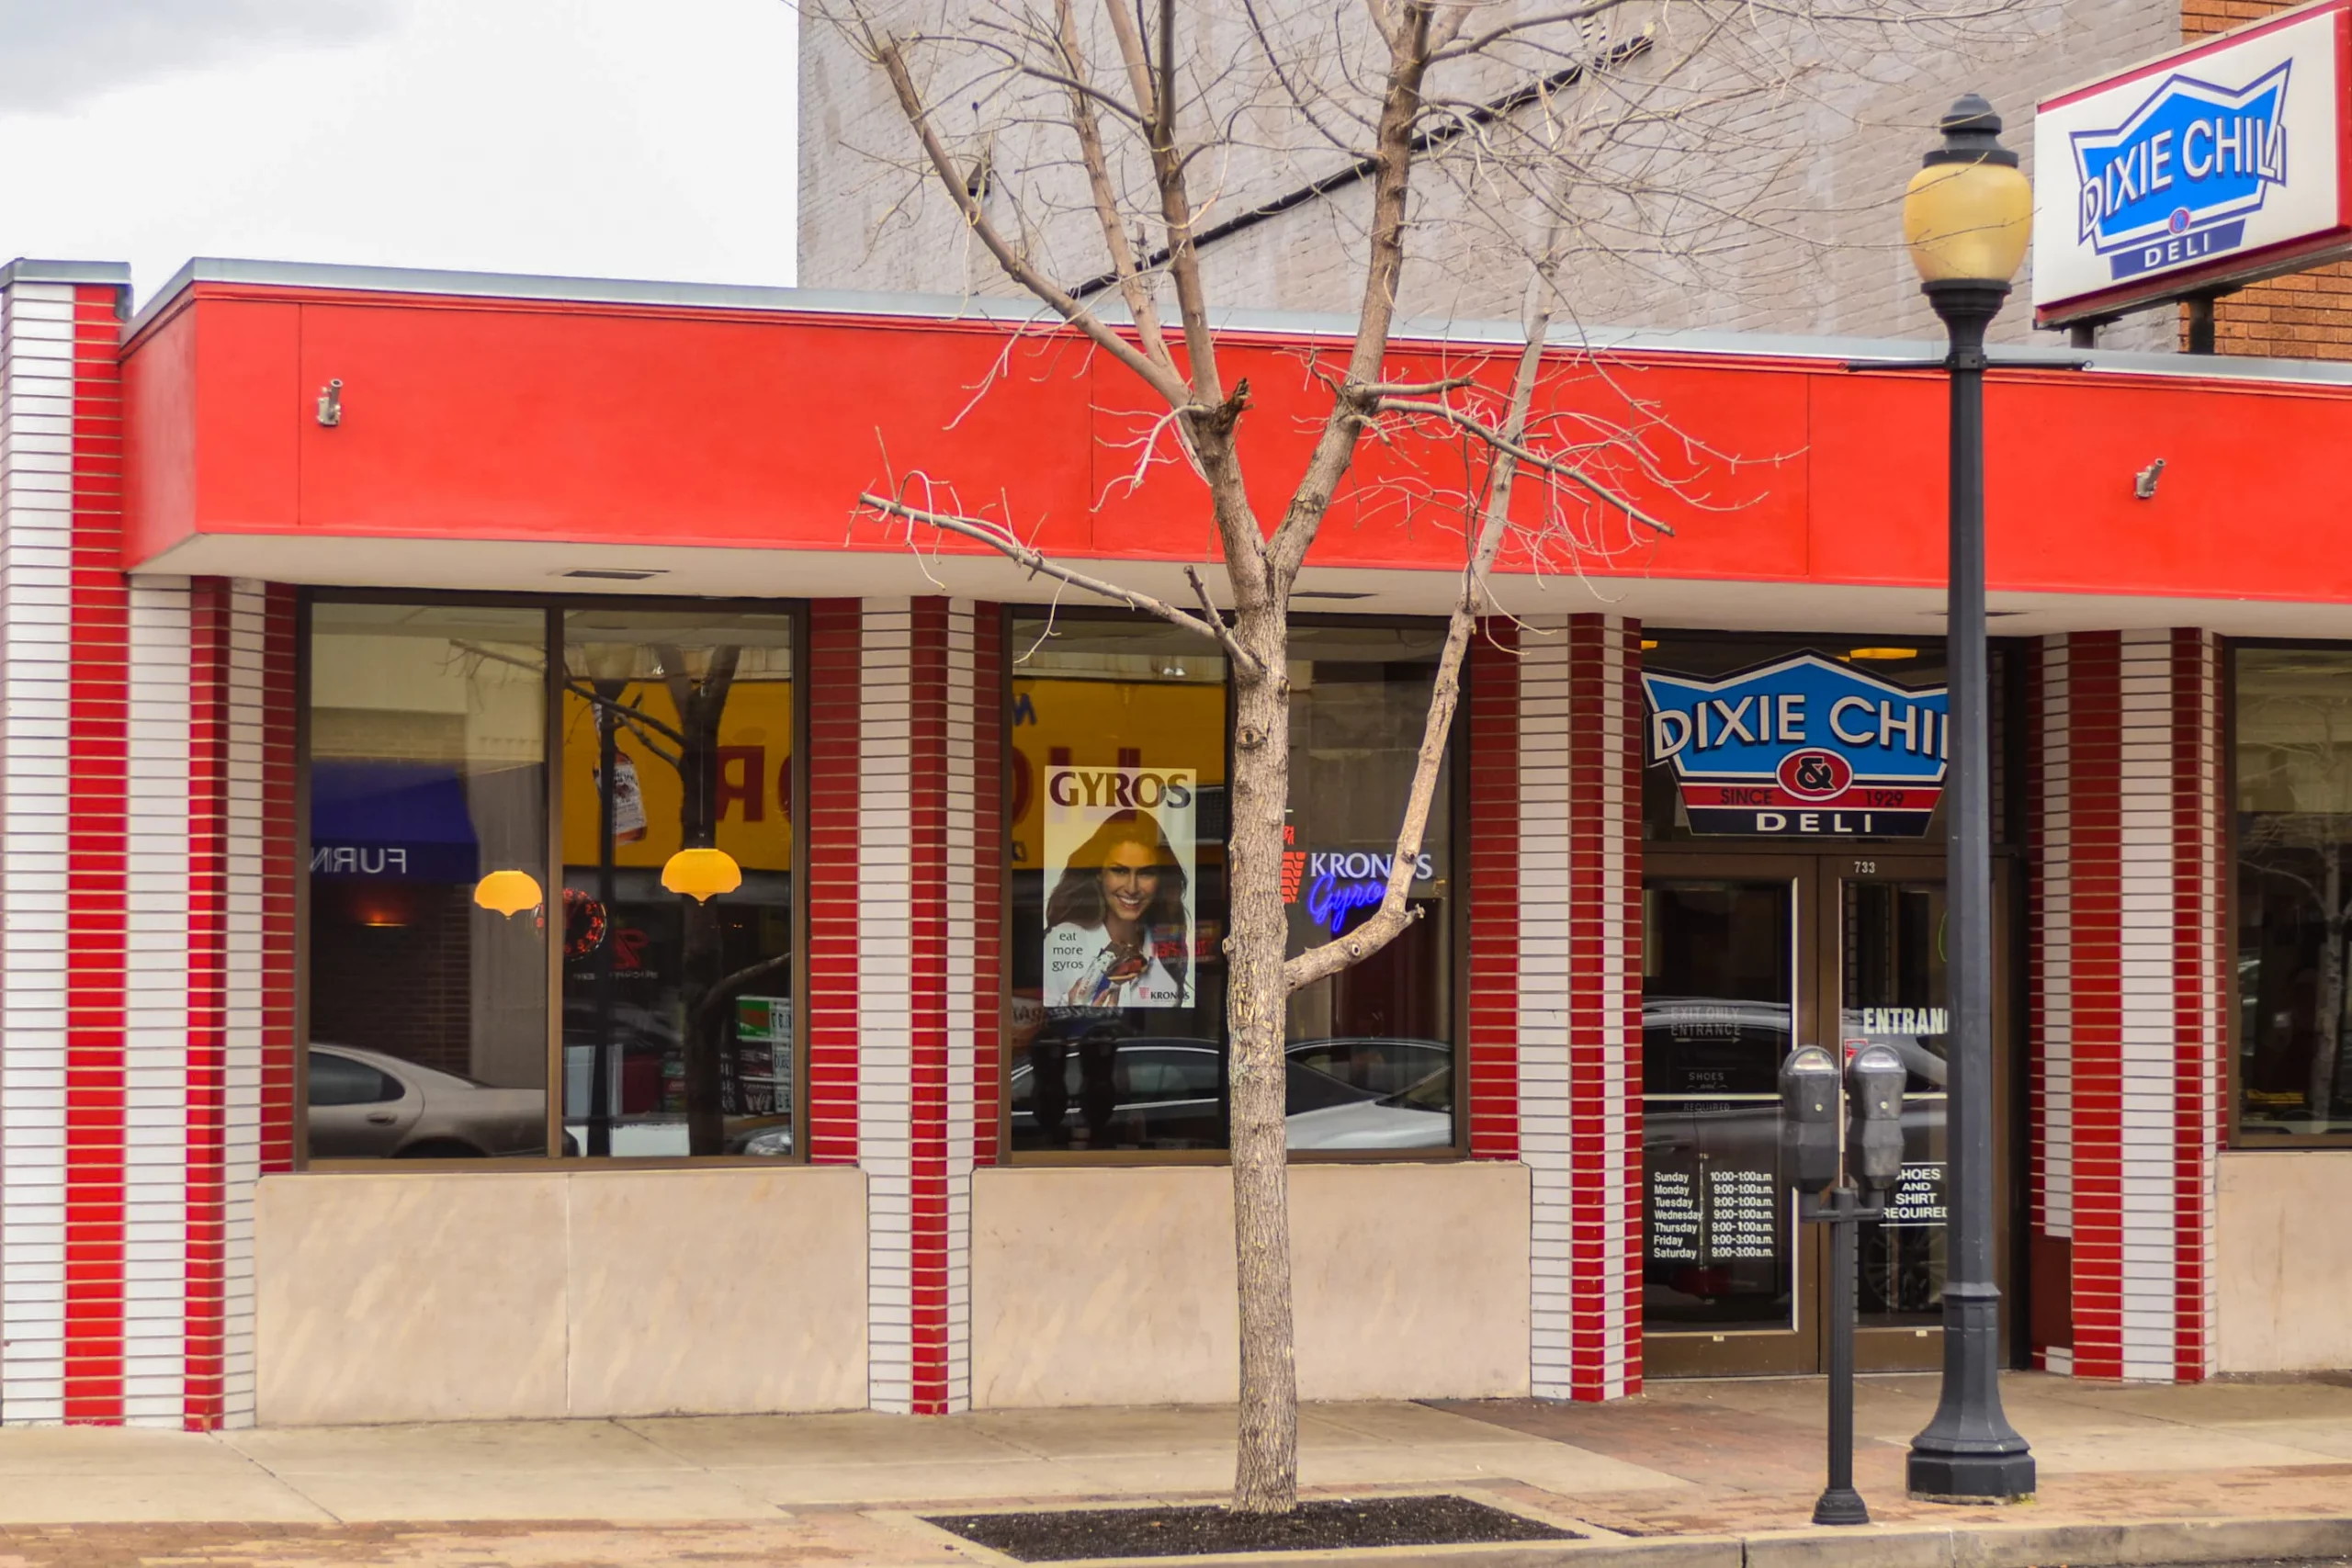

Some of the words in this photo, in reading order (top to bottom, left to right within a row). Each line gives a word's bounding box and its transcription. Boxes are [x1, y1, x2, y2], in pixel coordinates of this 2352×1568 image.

[2081, 129, 2173, 240] DIXIE
[2181, 116, 2284, 183] CHILI
[2143, 231, 2210, 269] DELI
[1651, 694, 1807, 761] DIXIE
[1828, 695, 1948, 761] CHI
[1795, 755, 1837, 792] &
[1049, 771, 1192, 809] GYROS
[1720, 787, 1773, 806] SINCE
[1865, 790, 1905, 807] 1929
[1756, 812, 1872, 833] DELI
[1309, 852, 1433, 879] KRONS
[1854, 861, 1876, 874] 733
[1307, 872, 1389, 933] Gyro
[1059, 931, 1077, 942] eat
[1053, 945, 1084, 955] more
[1052, 961, 1084, 972] gyros
[1863, 1007, 1948, 1035] ENTRAN
[1670, 1023, 1742, 1037] ENTRANCE
[1689, 1072, 1724, 1081] SHOES
[1654, 1171, 1690, 1184] Sunday
[1654, 1184, 1690, 1197] Monday
[1901, 1181, 1931, 1191] AND
[1654, 1197, 1693, 1210] Tuesday
[1894, 1192, 1938, 1205] SHIRT
[1654, 1210, 1703, 1222] Wednesday
[1654, 1222, 1698, 1235] Thursday
[1654, 1235, 1683, 1247] Friday
[1654, 1247, 1698, 1260] Saturday
